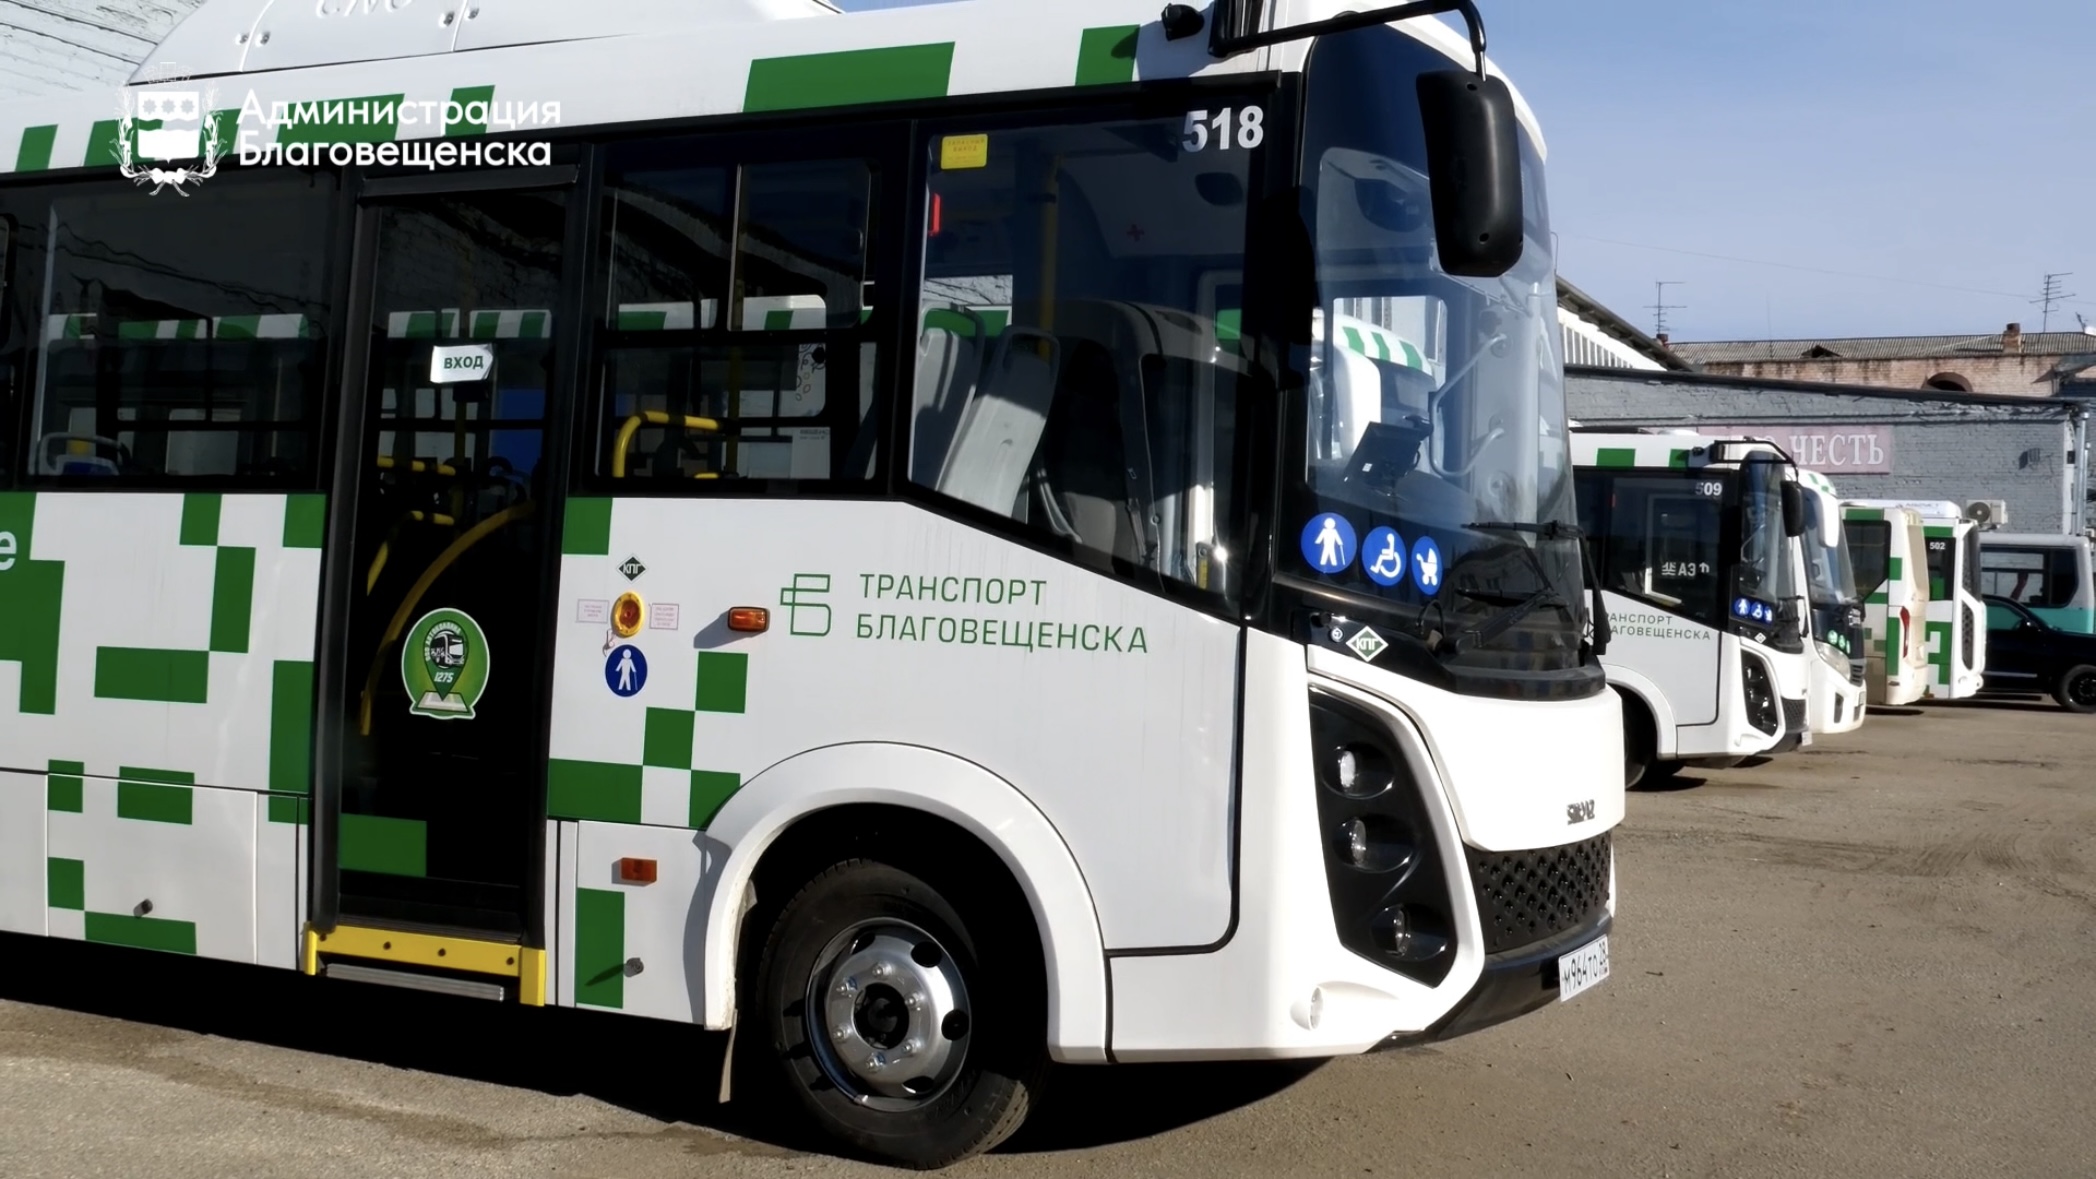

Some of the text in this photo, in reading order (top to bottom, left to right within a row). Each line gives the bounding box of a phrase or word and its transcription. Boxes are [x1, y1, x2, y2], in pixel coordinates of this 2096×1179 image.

[1182, 105, 1264, 153] 518
[443, 355, 484, 370] ВХОД
[1788, 434, 1884, 466] ЧЕСТЬ
[1695, 482, 1723, 496] 509
[1929, 541, 1946, 550] 502
[622, 563, 641, 575] КПГ
[859, 573, 1048, 606] ТРАНСПОРТ
[1608, 613, 1674, 626] АНСПОРТ
[856, 613, 1149, 654] БЛАГОВЕЩЕНСКА
[1610, 625, 1711, 641] АГОВЕЩЕНСКА
[1356, 637, 1380, 651] КПГ
[433, 671, 455, 684] 1275
